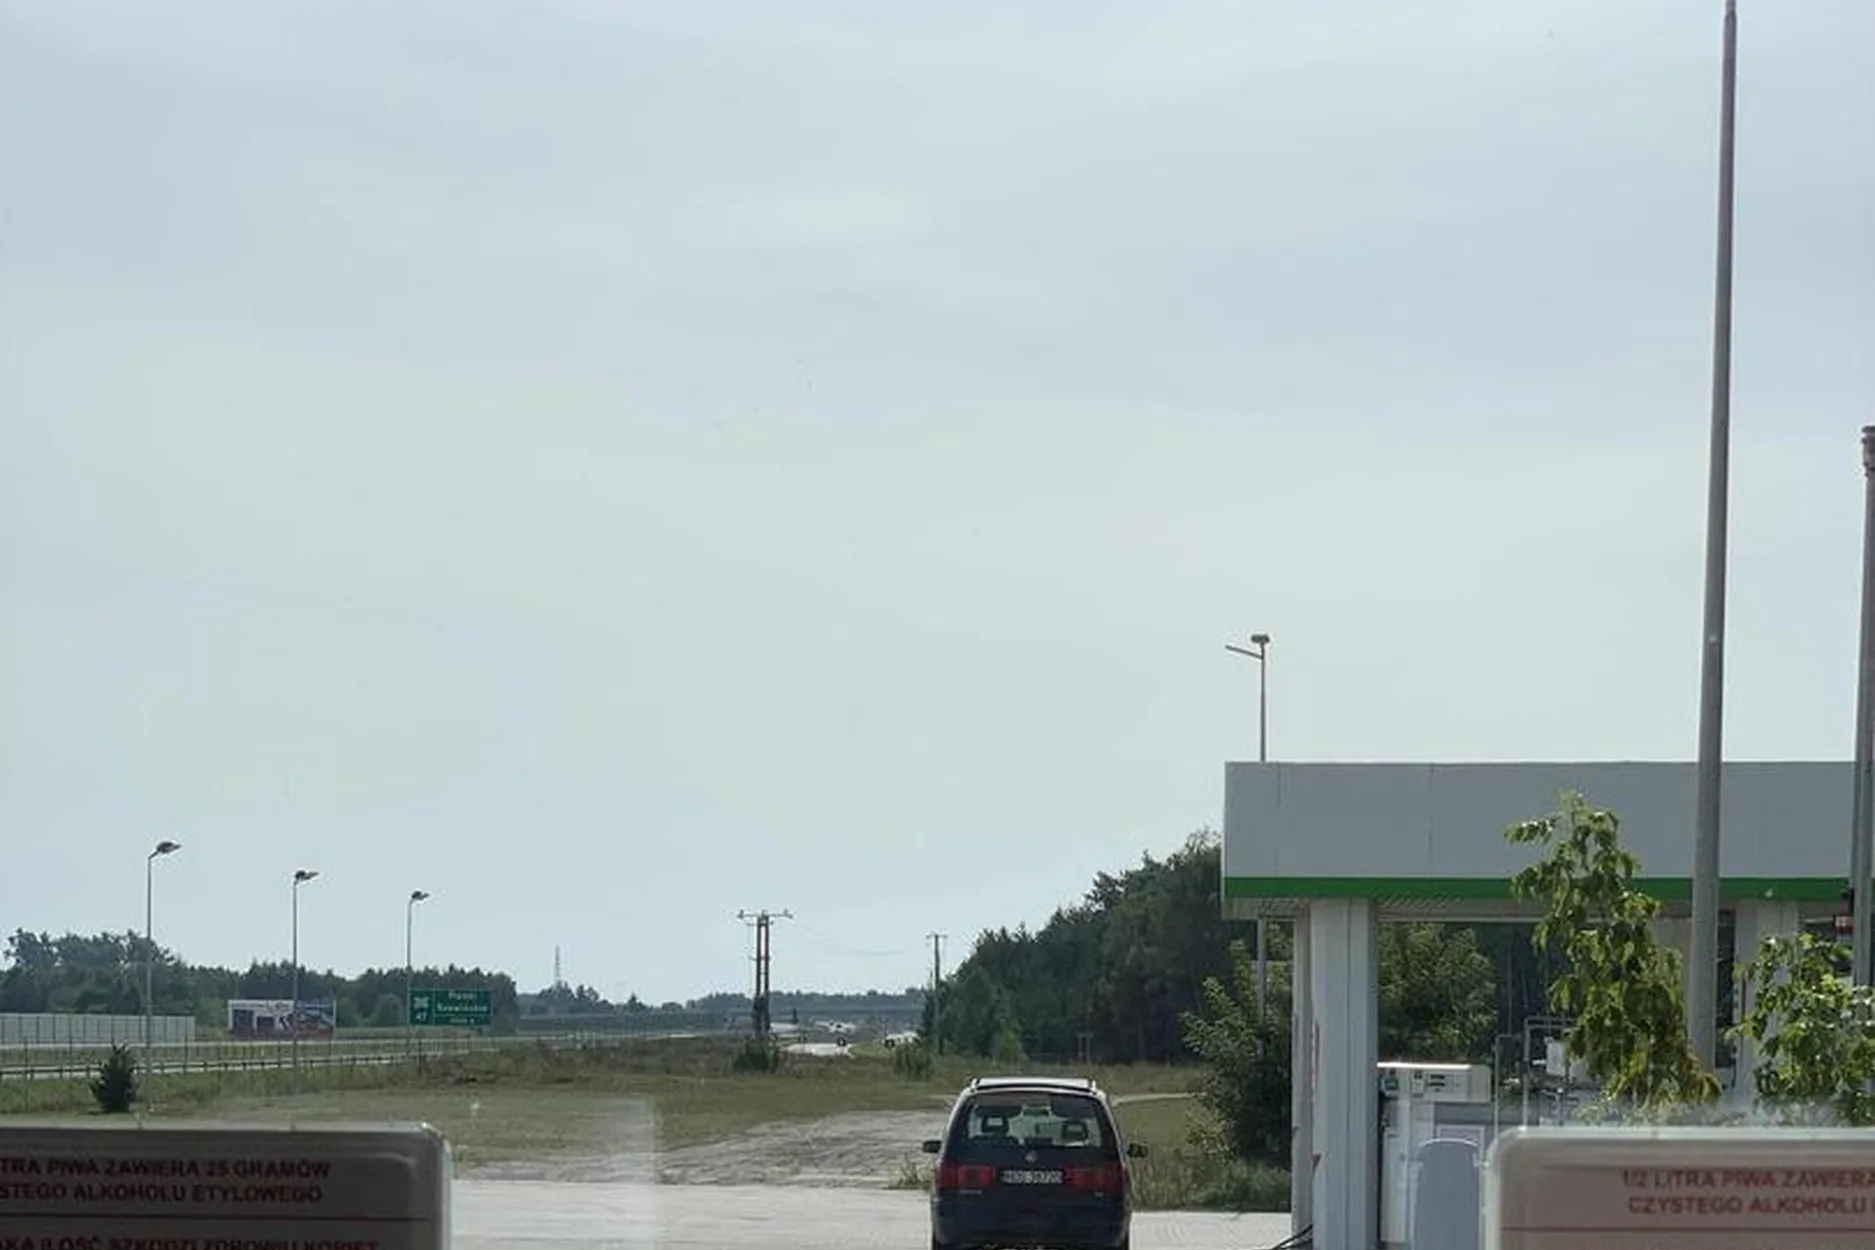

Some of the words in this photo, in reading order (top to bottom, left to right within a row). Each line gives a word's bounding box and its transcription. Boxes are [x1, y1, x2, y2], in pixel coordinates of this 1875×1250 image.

[47, 1160, 99, 1177] PIWA
[105, 1160, 200, 1177] ZAWIERA
[234, 1158, 332, 1178] GRAMÓW
[1655, 1169, 1716, 1187] LITRA
[1722, 1169, 1775, 1187] PIWA
[74, 1184, 187, 1203] ALKOHOLU
[192, 1184, 322, 1205] ETYLOWEGO
[1629, 1196, 1743, 1214] CZYSTEGO
[1749, 1197, 1866, 1214] ALKOHOLU
